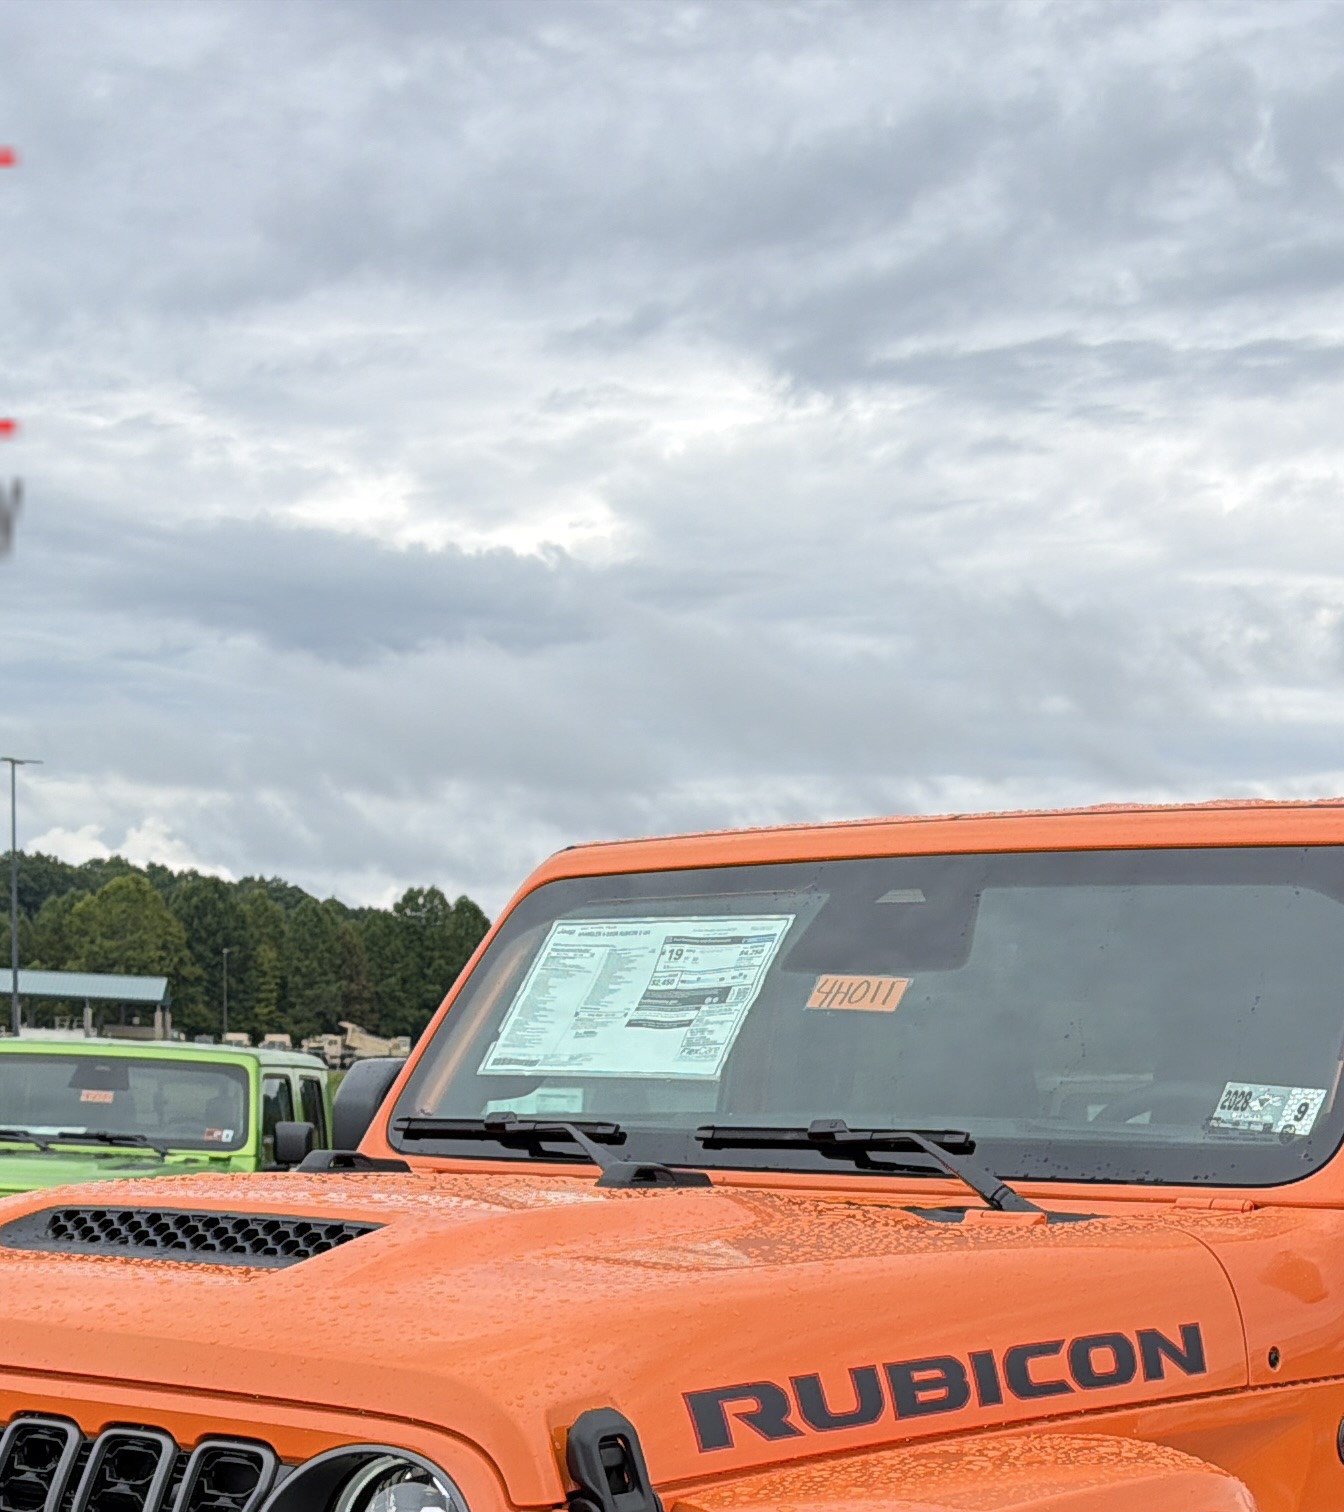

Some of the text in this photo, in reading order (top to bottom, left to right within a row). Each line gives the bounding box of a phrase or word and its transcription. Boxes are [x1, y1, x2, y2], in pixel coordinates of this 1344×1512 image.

[1219, 1089, 1310, 1122] 2028 9
[680, 1321, 1208, 1454] RUBICON
